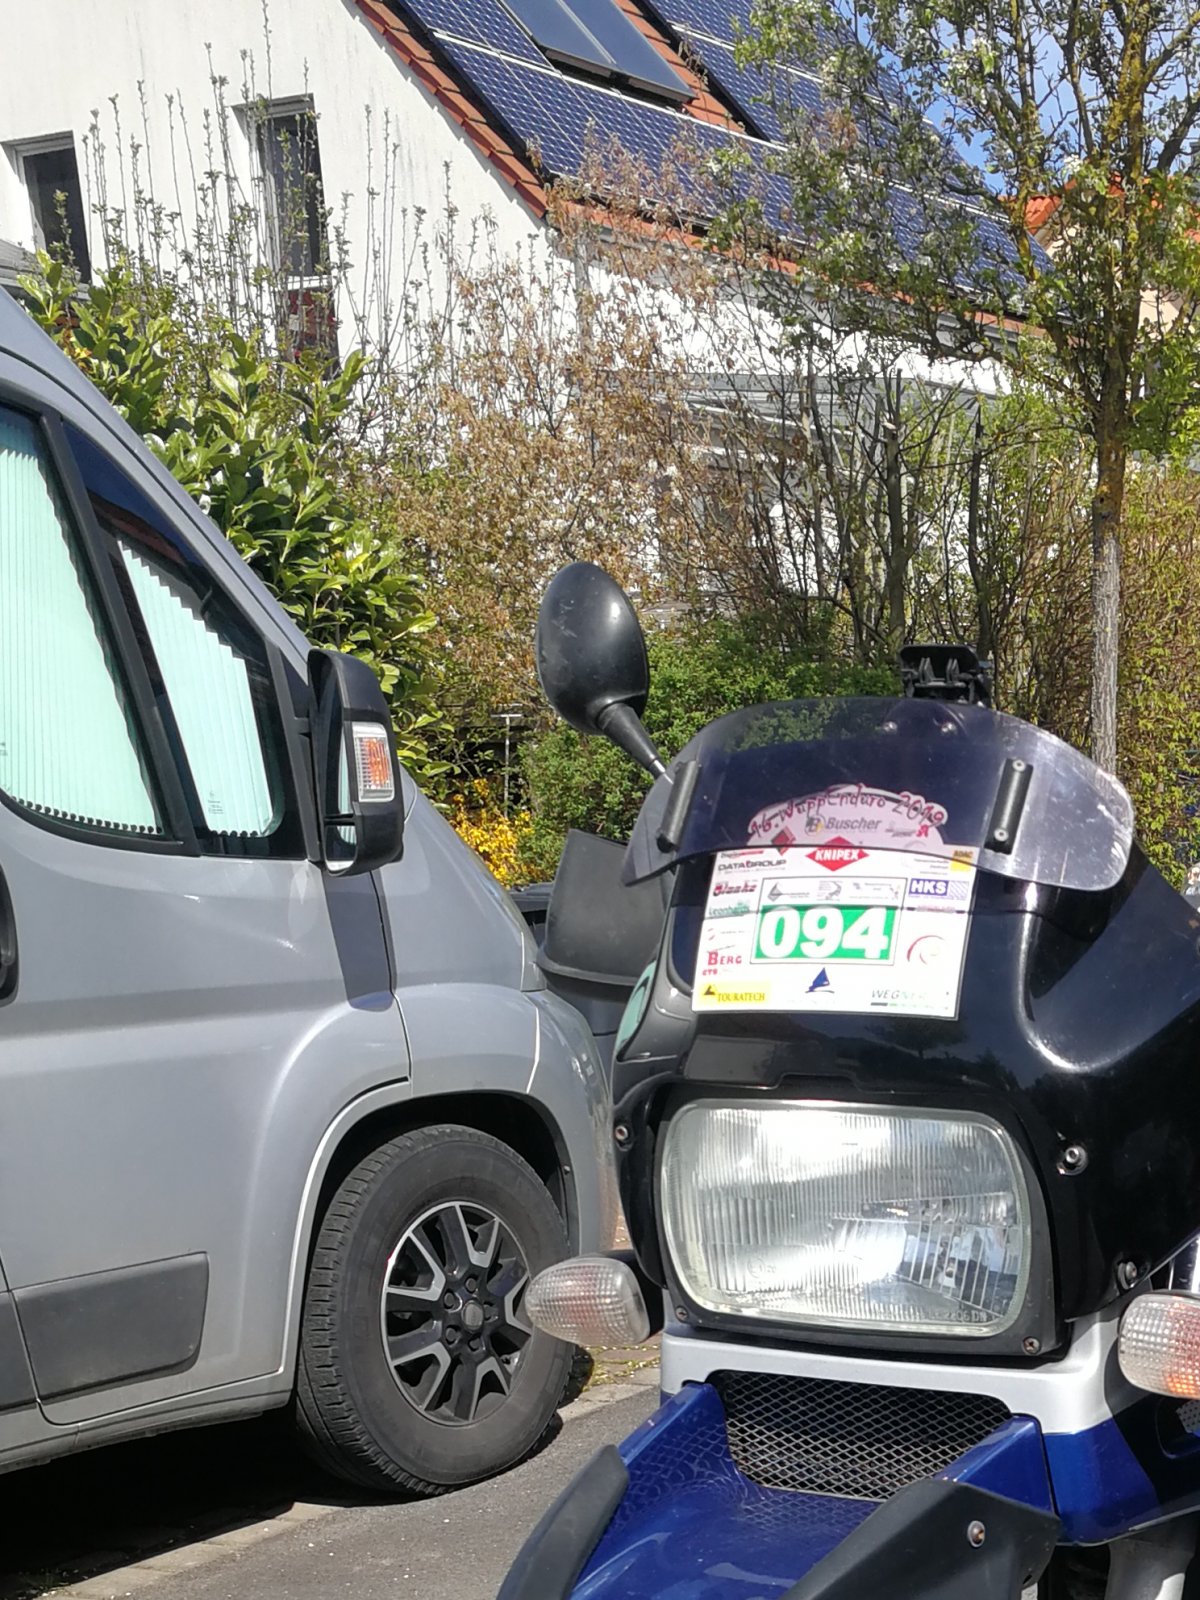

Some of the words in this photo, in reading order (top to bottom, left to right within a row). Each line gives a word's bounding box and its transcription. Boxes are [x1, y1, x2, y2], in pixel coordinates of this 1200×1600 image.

[892, 793, 945, 829] 2019
[825, 816, 882, 831] Buscher
[814, 848, 861, 861] KNIPEX
[717, 859, 787, 872] DATAGROUP
[910, 880, 948, 894] HKS
[759, 906, 889, 959] 094
[708, 951, 742, 966] BERG
[718, 992, 765, 1003] TOURATECH
